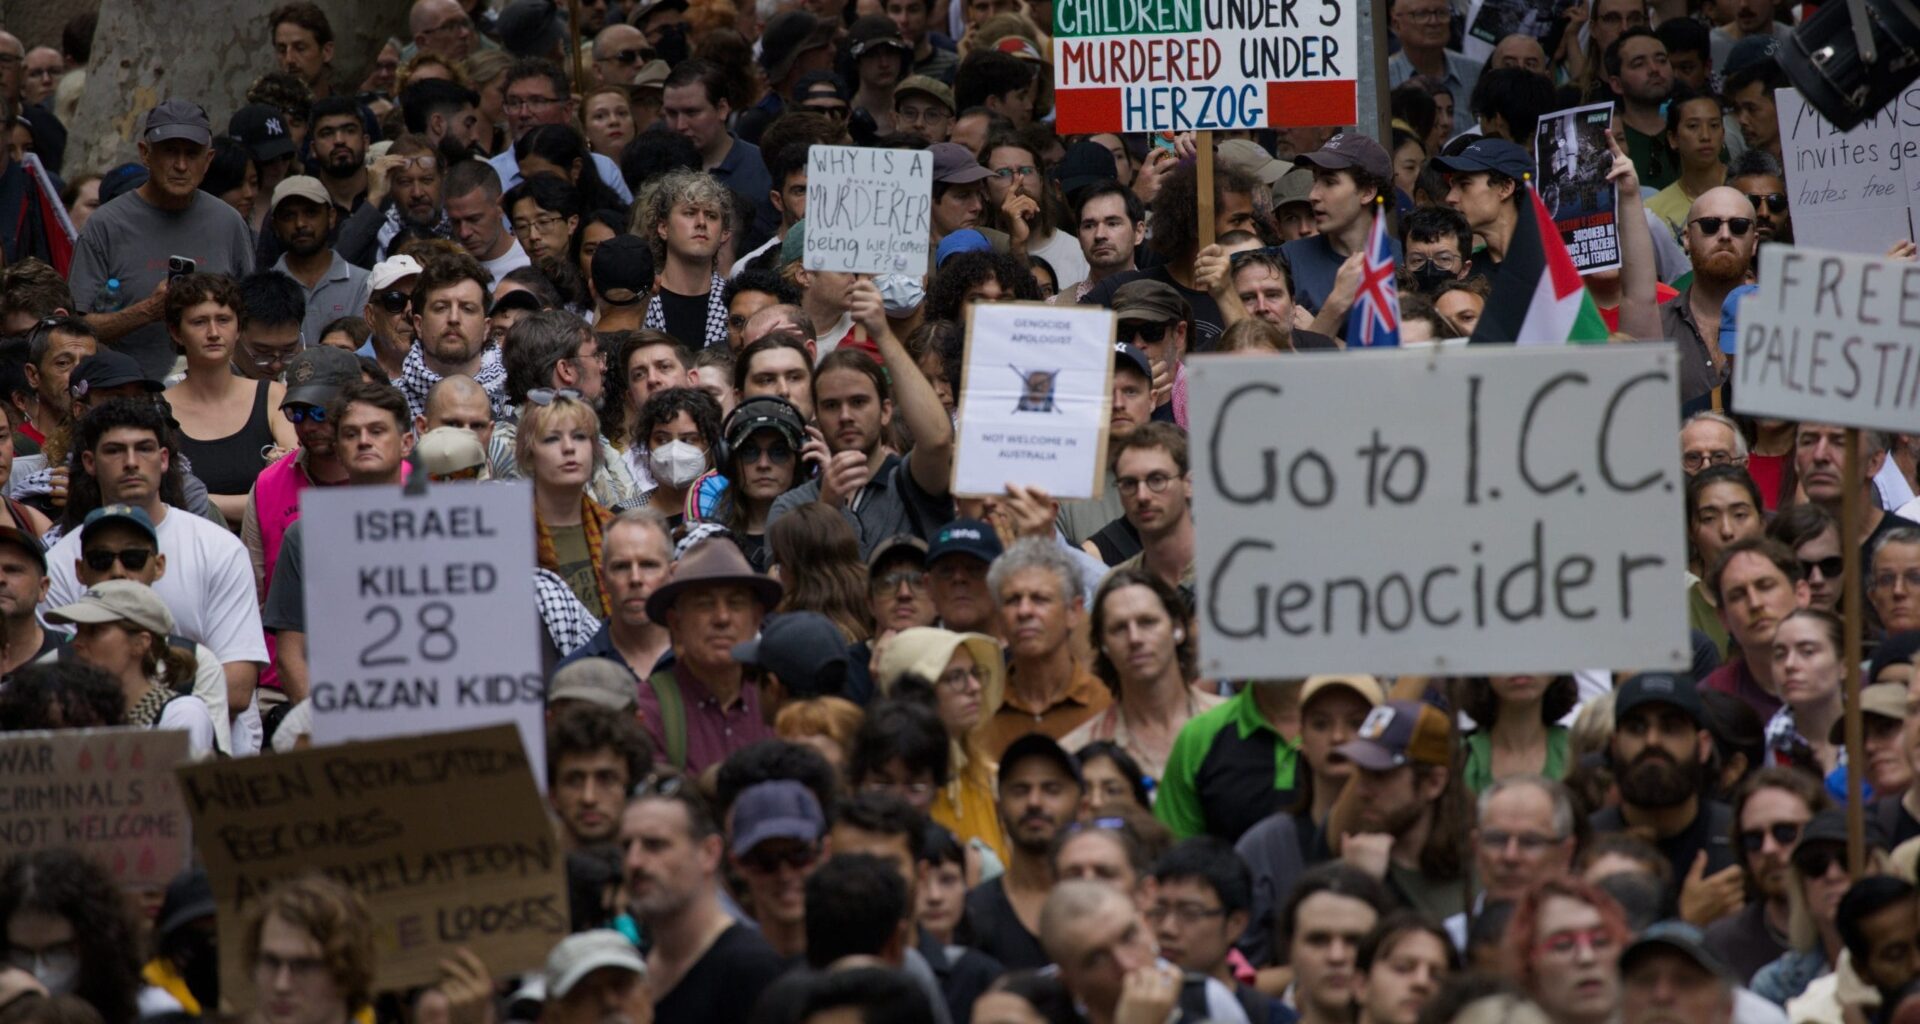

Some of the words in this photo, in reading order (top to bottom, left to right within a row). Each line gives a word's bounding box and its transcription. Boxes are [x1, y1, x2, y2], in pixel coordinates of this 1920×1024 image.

[1057, 0, 1193, 33] CHILDREN
[1205, 0, 1299, 31] UNDER
[1062, 38, 1222, 85] MURDERED
[1240, 36, 1341, 79] UNDER
[1126, 84, 1264, 131] HERZOG
[1792, 88, 1920, 140] MNS
[812, 149, 859, 175] WHY
[871, 150, 895, 175] IS
[908, 152, 924, 178] A
[1796, 139, 1879, 173] invites
[1889, 140, 1920, 171] ge
[1798, 179, 1848, 206] hates
[1862, 174, 1897, 199] free
[808, 183, 930, 236] MURDERER
[807, 228, 860, 269] being
[1573, 226, 1605, 242] GENOCIDE
[1580, 241, 1589, 254] IS
[1589, 237, 1616, 252] HERZOG
[1572, 252, 1590, 267] PRES
[1591, 248, 1616, 264] ISRAELI
[1777, 253, 1920, 329] FREE
[1011, 334, 1073, 345] APOLOGIST
[1013, 318, 1072, 330] GENOCIDE
[1741, 323, 1920, 409] PALESTI
[981, 433, 1004, 443] NOT
[1006, 435, 1062, 446] WELCOME
[1065, 438, 1077, 447] IN
[998, 450, 1058, 462] AUSTRALIA
[1207, 381, 1337, 509] Go
[1356, 428, 1428, 508] to
[1464, 371, 1675, 505] I.C.C.
[355, 506, 498, 542] ISRAEL
[358, 562, 498, 598] KILLED
[1206, 519, 1667, 641] Genocider
[358, 600, 459, 668] 28
[311, 677, 440, 714] GAZAN
[456, 671, 545, 707] KIDS
[186, 764, 312, 814] WHEN
[64, 811, 179, 842] WELCOME
[217, 807, 406, 864] BECOMES
[436, 892, 566, 944] LOOSES
